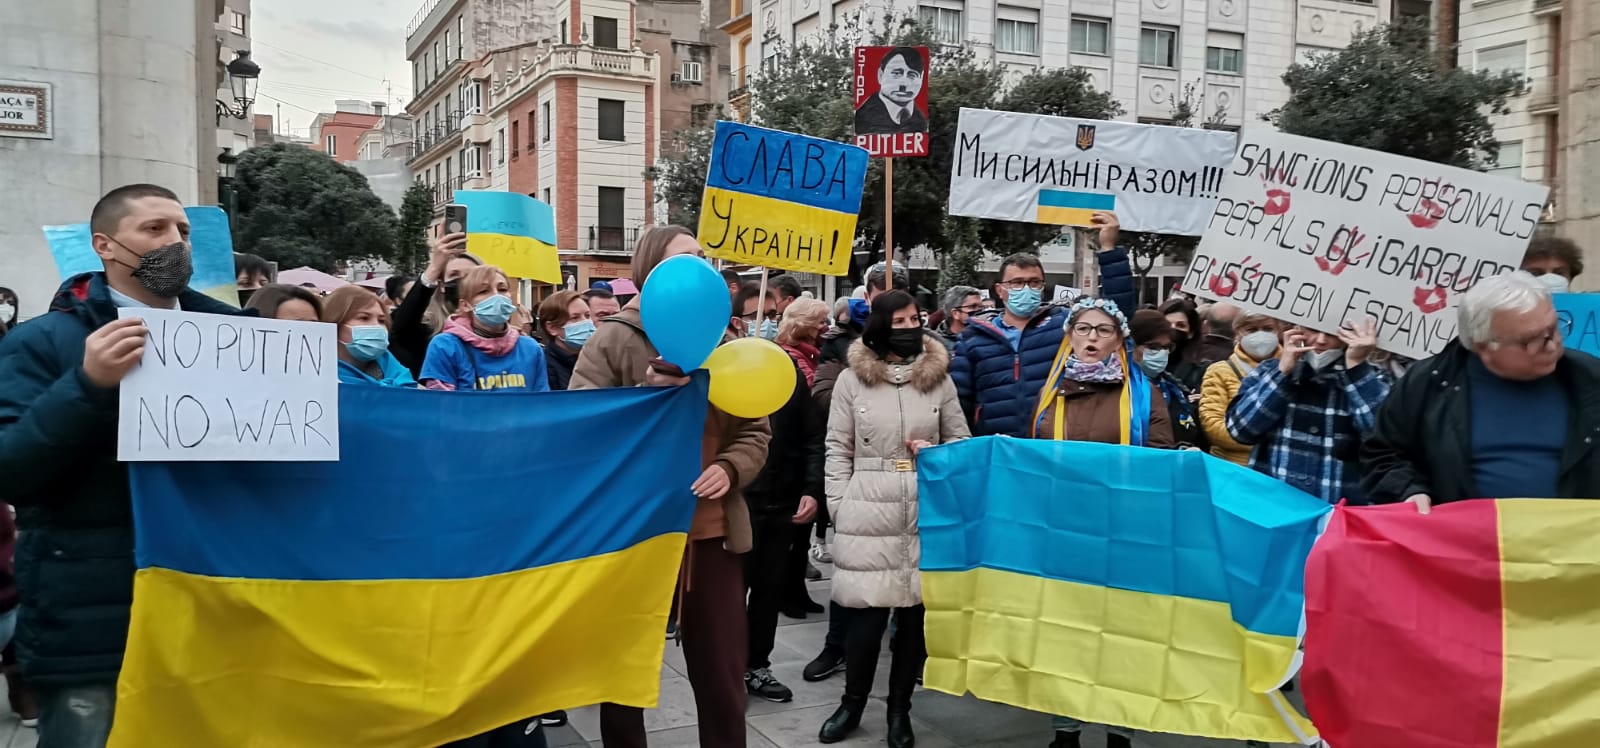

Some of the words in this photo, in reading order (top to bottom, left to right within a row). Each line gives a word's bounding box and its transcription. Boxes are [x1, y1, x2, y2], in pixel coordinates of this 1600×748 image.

[856, 48, 867, 104] STOP
[721, 131, 846, 200] СЛАВА
[856, 132, 925, 155] PUTLER
[138, 318, 202, 368] NO
[1338, 287, 1456, 355] ESPANY
[138, 394, 210, 451] NO
[225, 397, 332, 446] WAR
